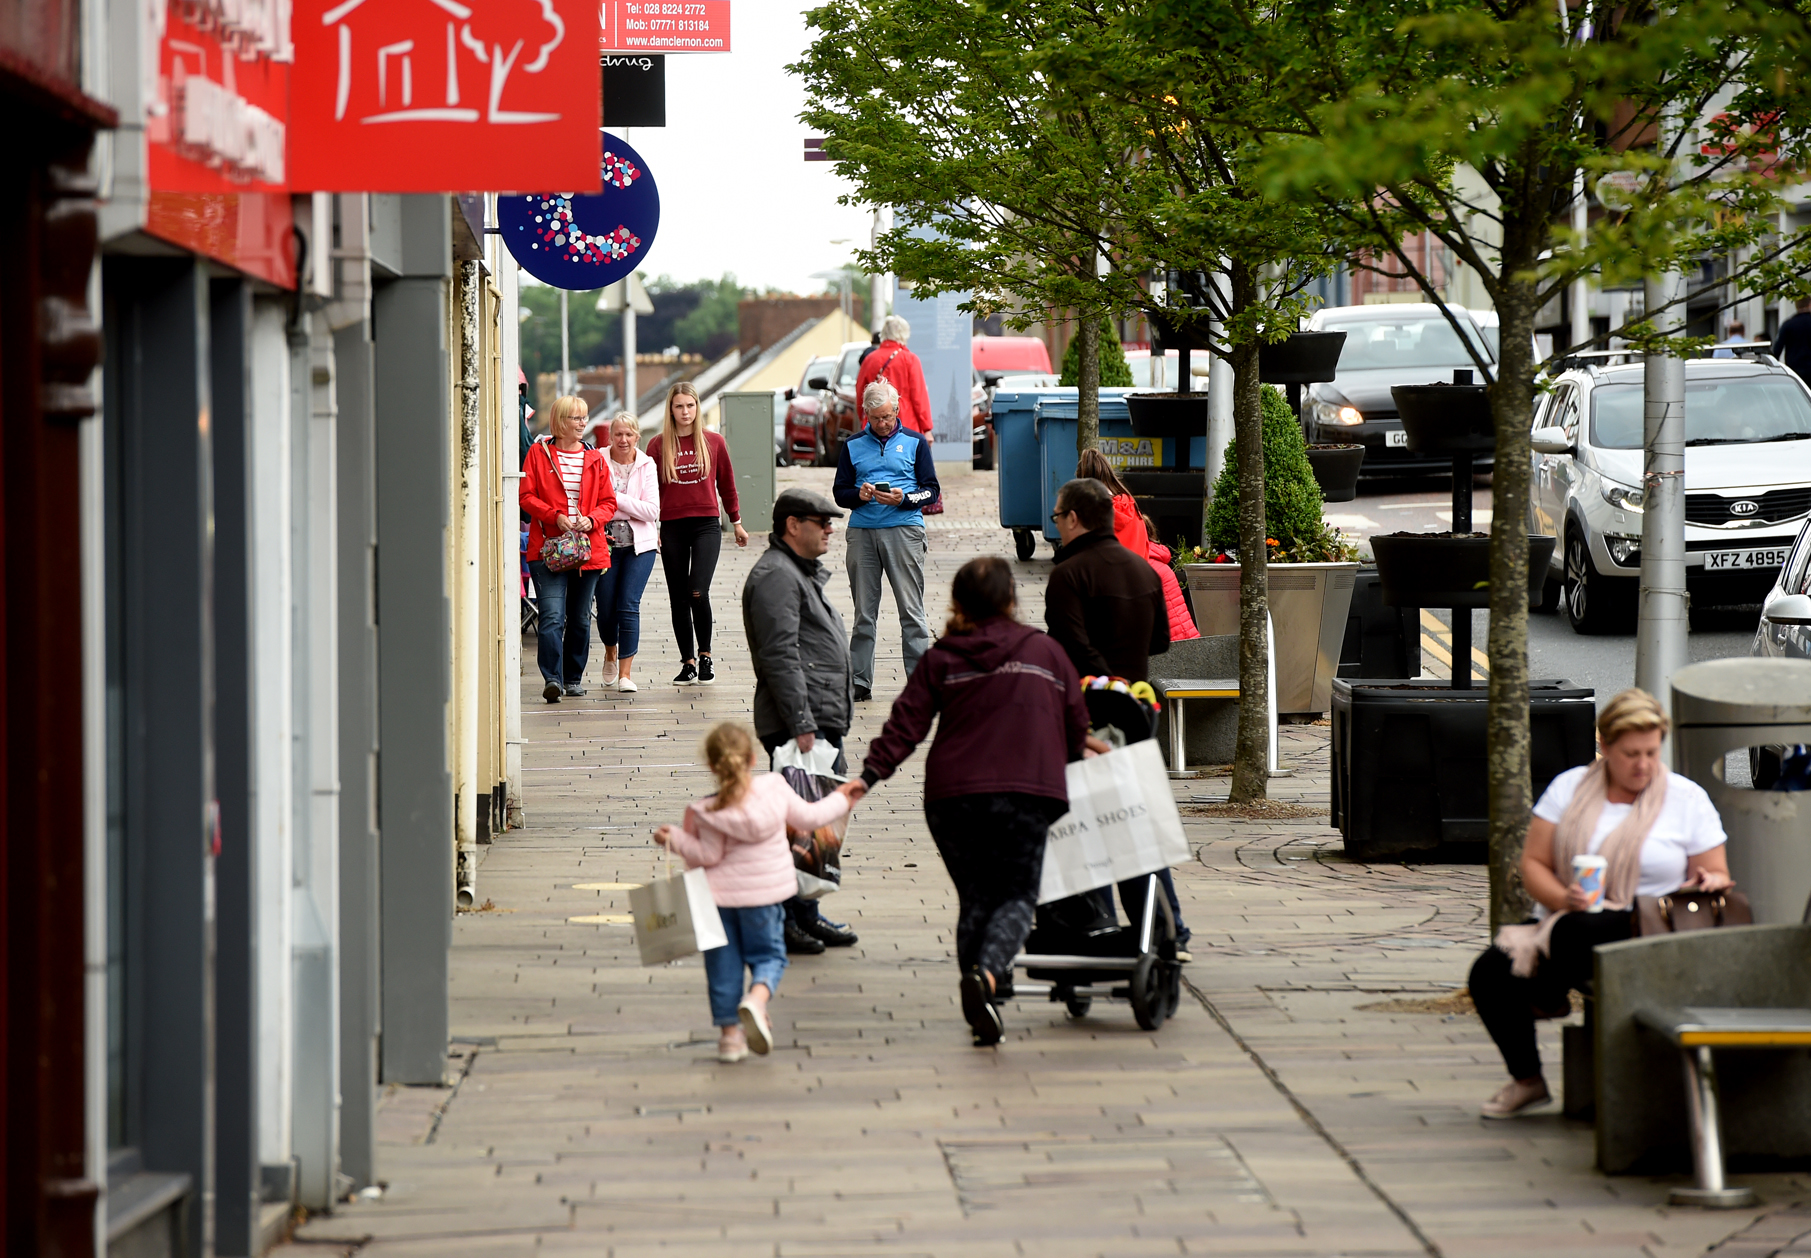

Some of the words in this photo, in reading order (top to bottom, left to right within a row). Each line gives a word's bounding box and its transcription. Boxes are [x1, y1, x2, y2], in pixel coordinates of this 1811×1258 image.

[625, 2, 642, 14] Tel:
[644, 3, 660, 14] 028
[661, 3, 683, 15] 8224
[684, 4, 706, 15] 2772
[626, 18, 648, 30] Mob:
[650, 19, 676, 30] 07771
[678, 20, 710, 31] 813184
[625, 35, 723, 47] www.damclernon.com
[1099, 439, 1154, 456] M&A
[1127, 455, 1154, 467] HIRE
[1734, 503, 1754, 513] KIA
[1710, 553, 1740, 568] XFZ
[1745, 551, 1786, 566] 4895
[1095, 803, 1148, 829] SHOES
